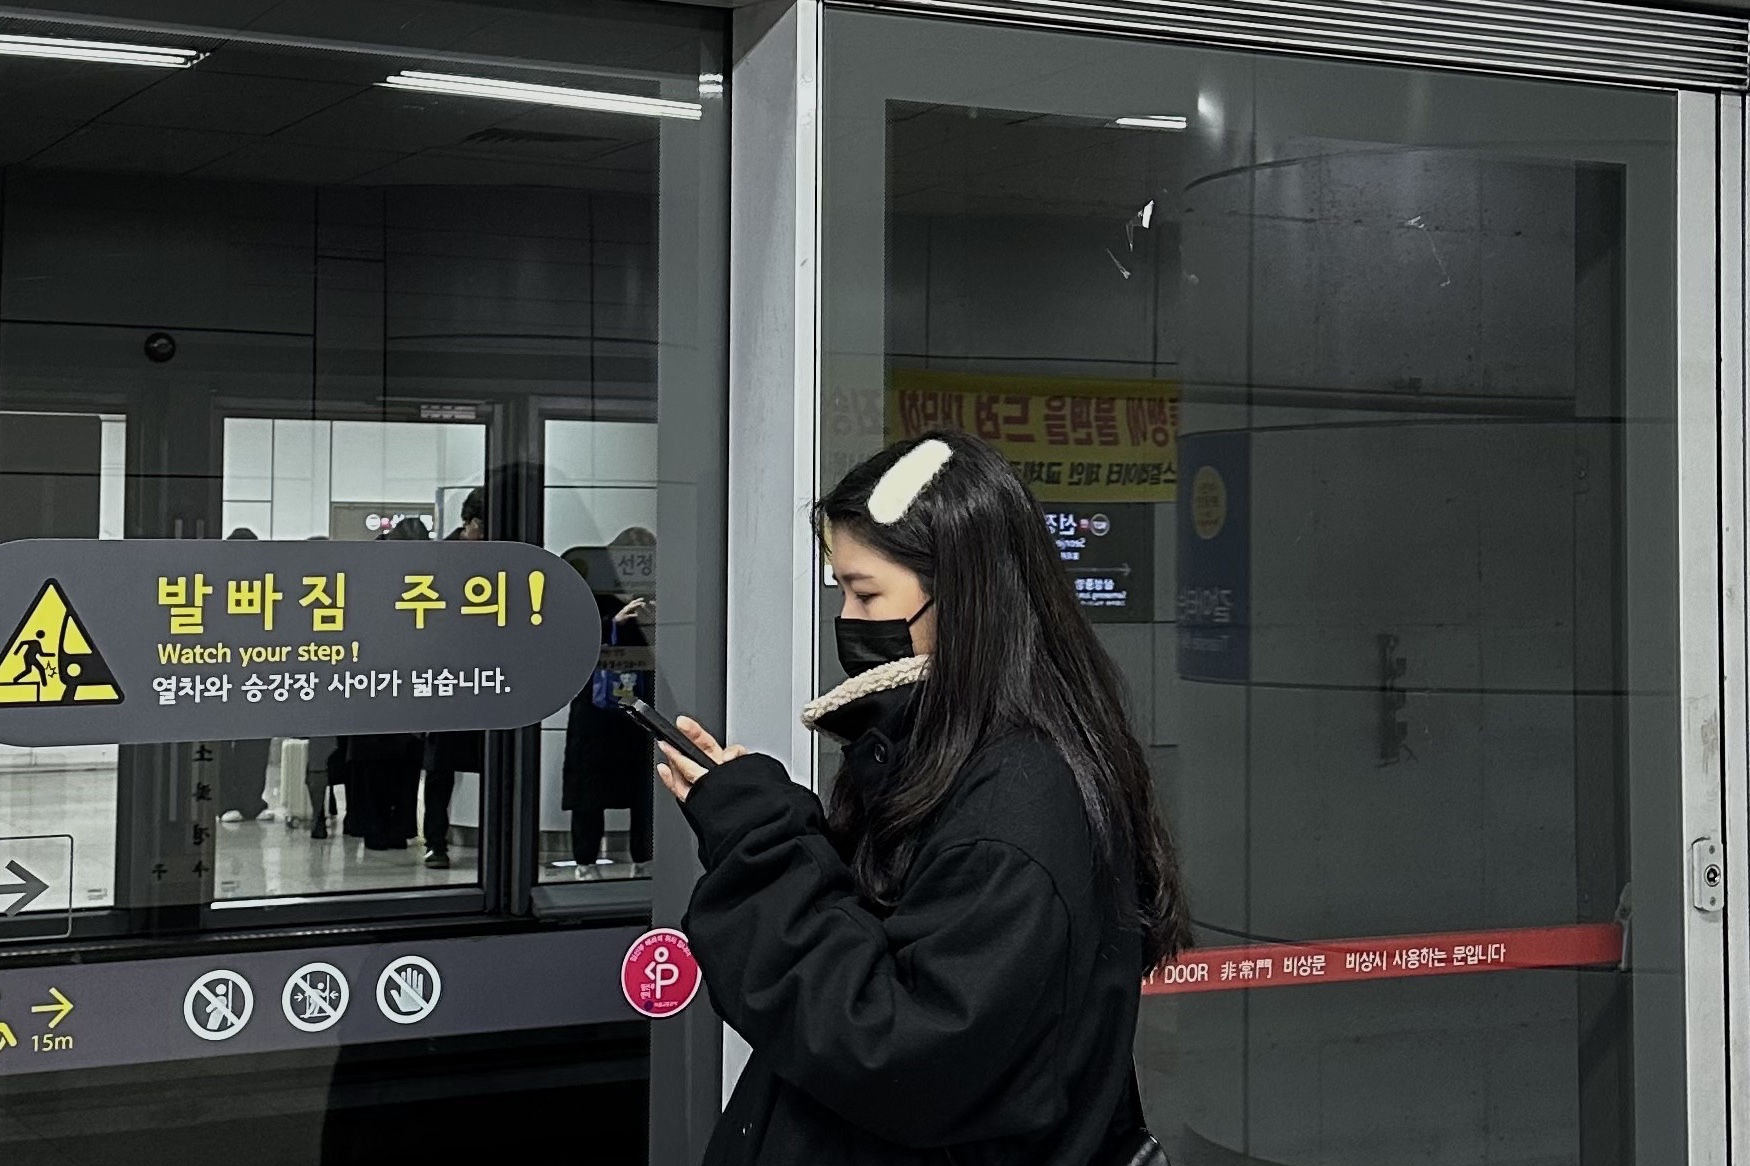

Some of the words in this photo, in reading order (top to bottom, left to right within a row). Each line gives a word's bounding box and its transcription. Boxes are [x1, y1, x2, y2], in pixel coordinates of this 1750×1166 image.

[158, 573, 345, 633] 발빠짐
[394, 569, 546, 628] 주의!
[158, 643, 231, 665] Watch
[240, 645, 291, 667] your
[152, 674, 233, 706] 열차와
[241, 671, 319, 702] 승강장
[328, 669, 402, 699] 사이가
[411, 667, 511, 697] 넓습니다.
[1164, 963, 1209, 984] DOOR
[1220, 958, 1272, 981] 非常門
[1283, 954, 1327, 977] 비상문
[1346, 950, 1387, 972] 비상시
[1393, 947, 1447, 970] 사용하는
[1453, 943, 1507, 966] 문입니다
[30, 1031, 74, 1053] 15m
